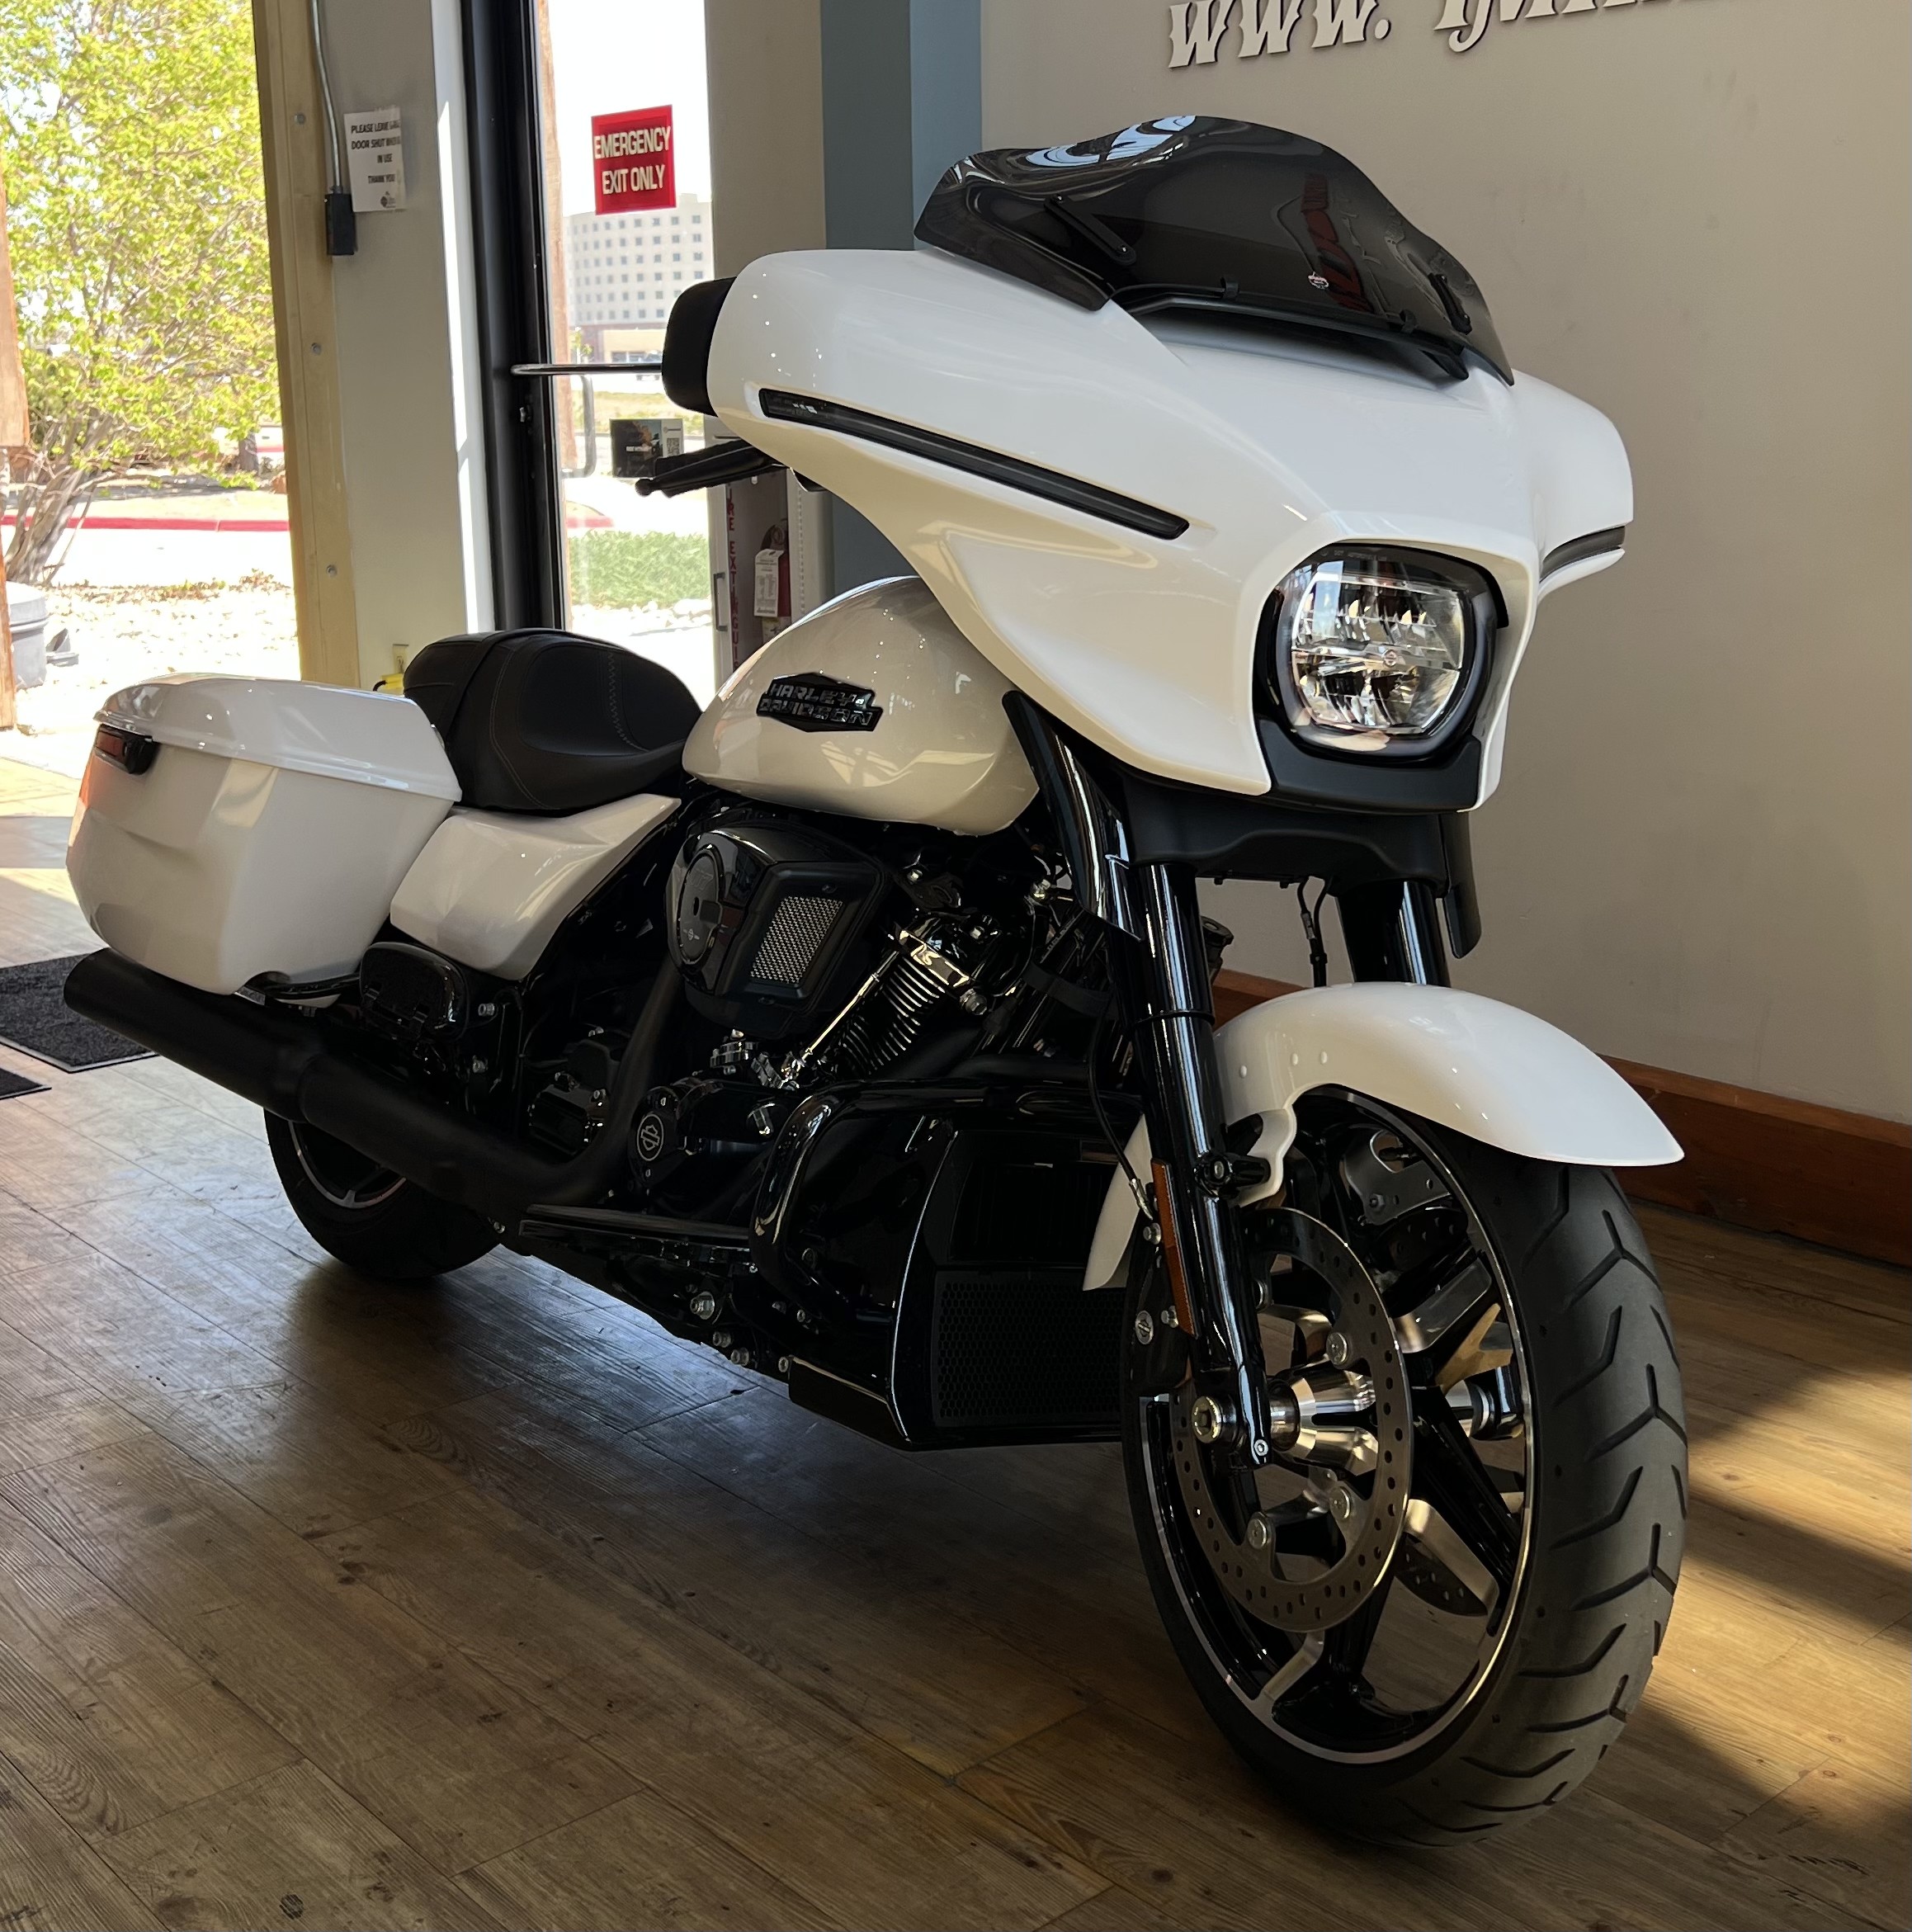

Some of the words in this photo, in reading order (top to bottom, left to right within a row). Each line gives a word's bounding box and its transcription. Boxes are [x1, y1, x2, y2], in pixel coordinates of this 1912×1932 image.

[351, 124, 373, 135] PLEASE
[594, 125, 671, 159] EMERGENCY
[352, 139, 370, 150] DOOR
[602, 168, 629, 195] EXIT
[630, 164, 665, 191] ONLY
[758, 698, 873, 725] DAVIDSON
